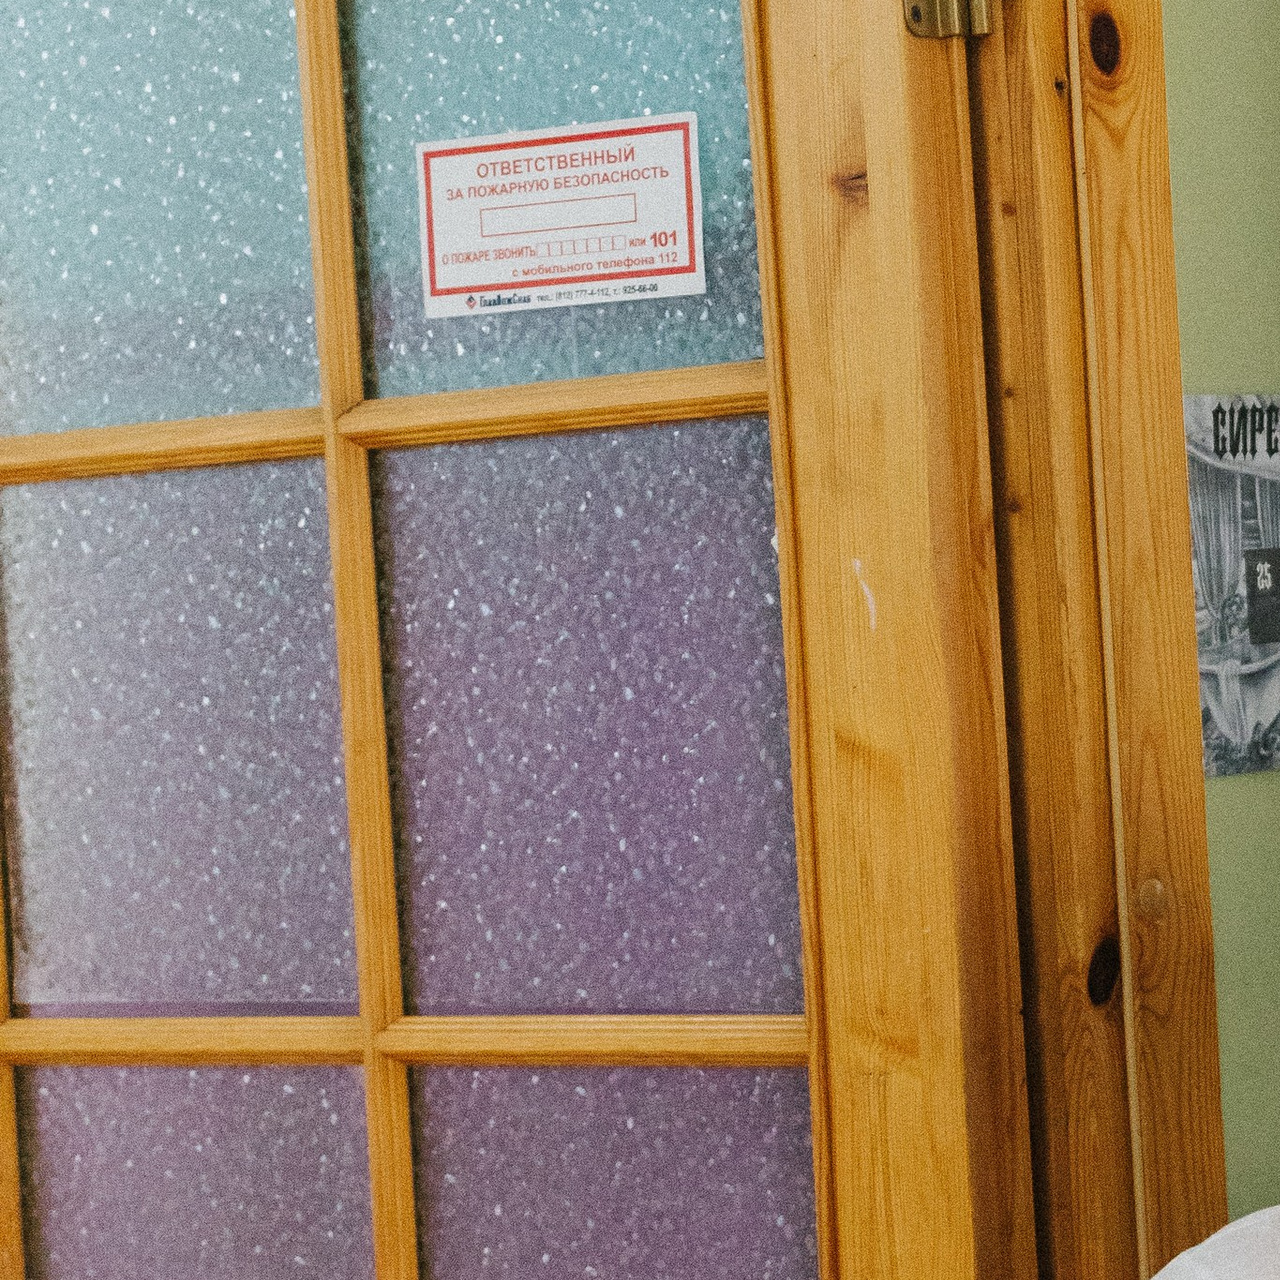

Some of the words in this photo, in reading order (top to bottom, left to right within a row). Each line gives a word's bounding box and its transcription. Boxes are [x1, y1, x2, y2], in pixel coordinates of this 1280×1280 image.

[476, 142, 636, 179] ОТВЕТСТВЕННЫЙ
[446, 186, 464, 201] ЗА
[467, 178, 550, 199] ПОЖАРНУЮ
[553, 165, 670, 189] БЕЗОПАСНОСТЬ
[441, 253, 449, 265] О
[450, 249, 490, 264] ПОЖАРЕ
[492, 245, 537, 261] ЗВОНИТЬ
[628, 237, 646, 247] или
[649, 230, 678, 248] 101
[511, 268, 518, 277] с
[521, 261, 593, 276] мобильного
[597, 255, 655, 270] телефона
[658, 252, 678, 264] 112
[1256, 561, 1272, 591] 25
